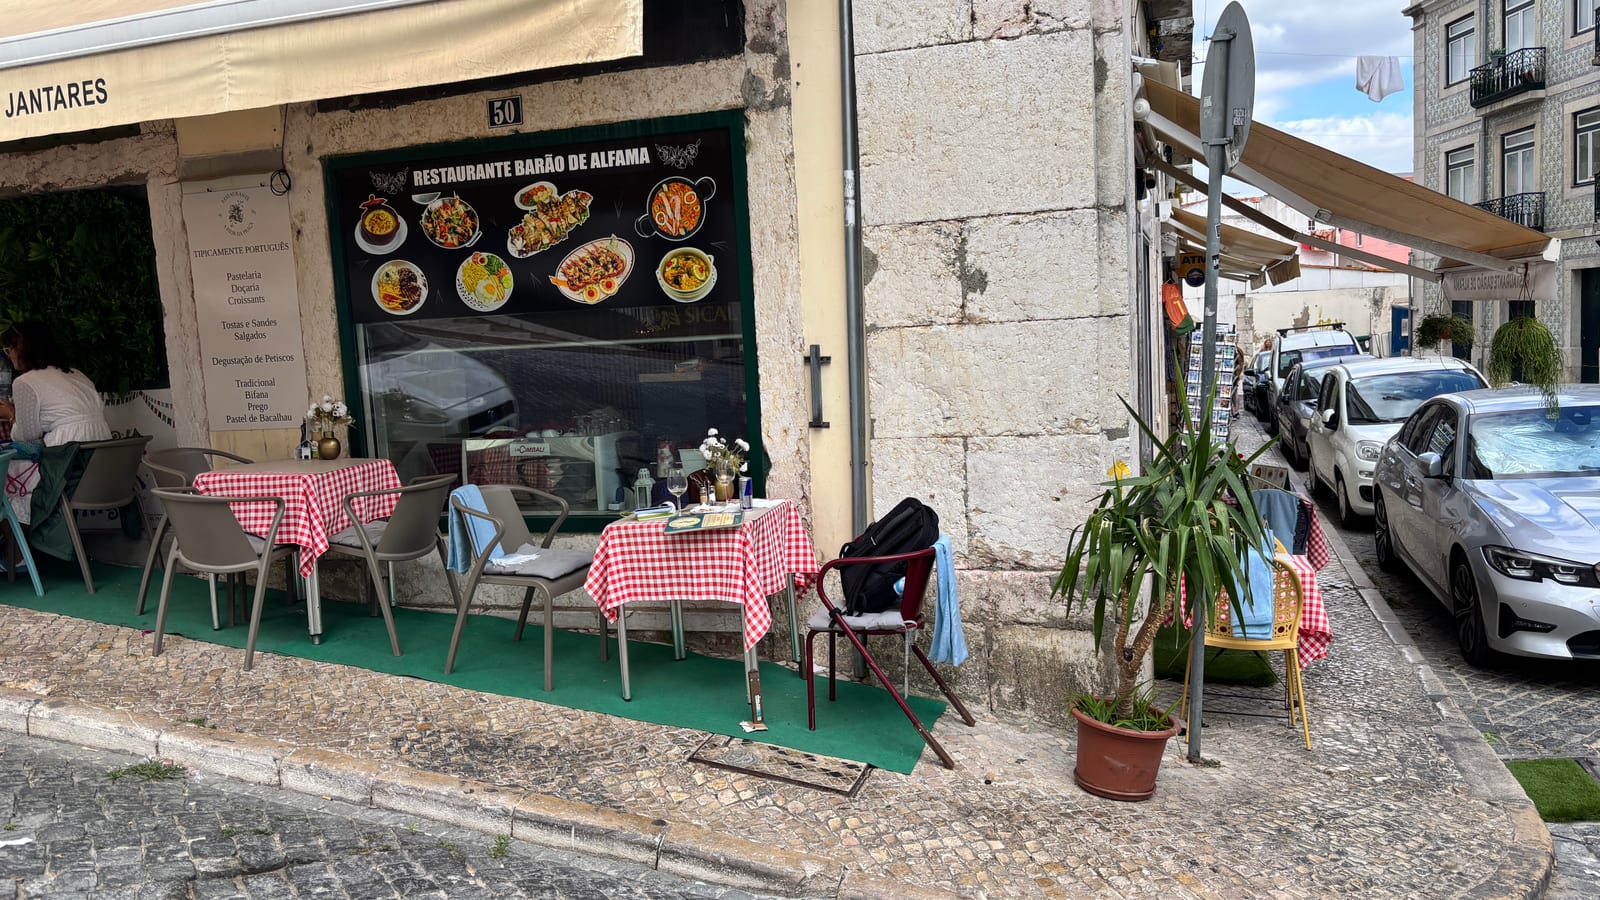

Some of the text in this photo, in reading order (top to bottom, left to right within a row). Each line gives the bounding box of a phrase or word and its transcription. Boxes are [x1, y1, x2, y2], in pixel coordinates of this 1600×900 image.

[5, 78, 107, 117] JANTARES
[494, 100, 515, 125] 50
[413, 147, 650, 187] RESTAURANTE BARÃO DE ALFAMA
[193, 241, 289, 258] TIPICAMENTE PORTUGUÊS
[227, 271, 262, 281] Pastelaria
[231, 283, 260, 294] Doçaria
[228, 296, 265, 305] Croissants
[222, 320, 244, 329] Tostas
[251, 318, 277, 327] Sandes
[234, 331, 267, 342] Salgados
[212, 353, 294, 367] Degustação de Petiscos
[235, 378, 275, 388] Tradicional
[245, 390, 269, 399] Bifana
[247, 402, 268, 413] Prego
[226, 413, 292, 424] Pastel de Bacalhau
